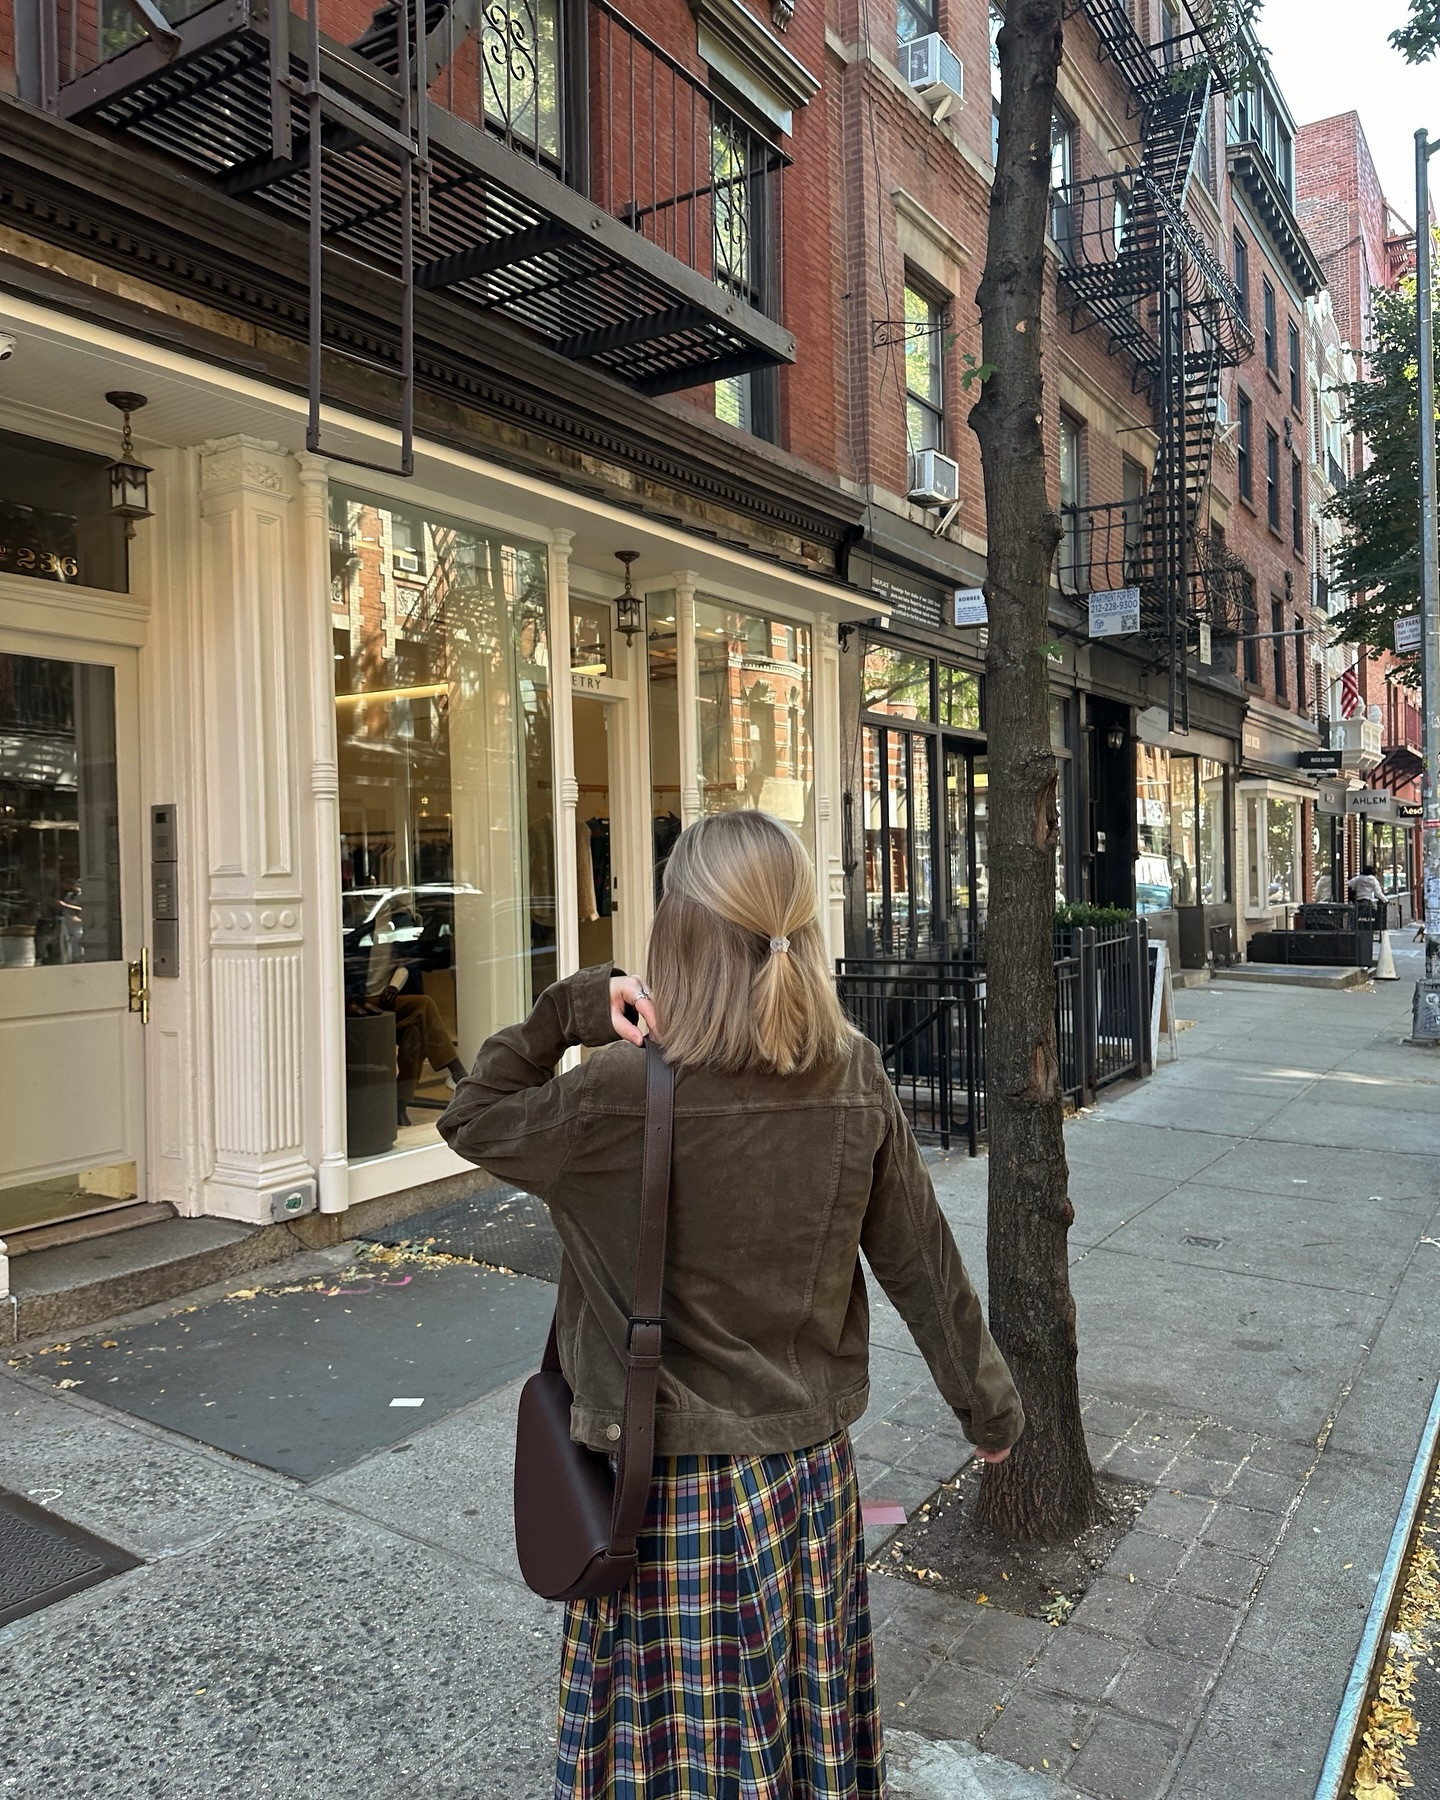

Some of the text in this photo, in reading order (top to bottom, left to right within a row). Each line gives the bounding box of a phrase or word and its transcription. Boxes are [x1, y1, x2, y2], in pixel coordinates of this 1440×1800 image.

[16, 546, 78, 577] 236
[1090, 589, 1138, 604] APARTMENT FOR RENT
[1091, 599, 1138, 613] 212-228-9300
[1352, 796, 1387, 805] AHLEM
